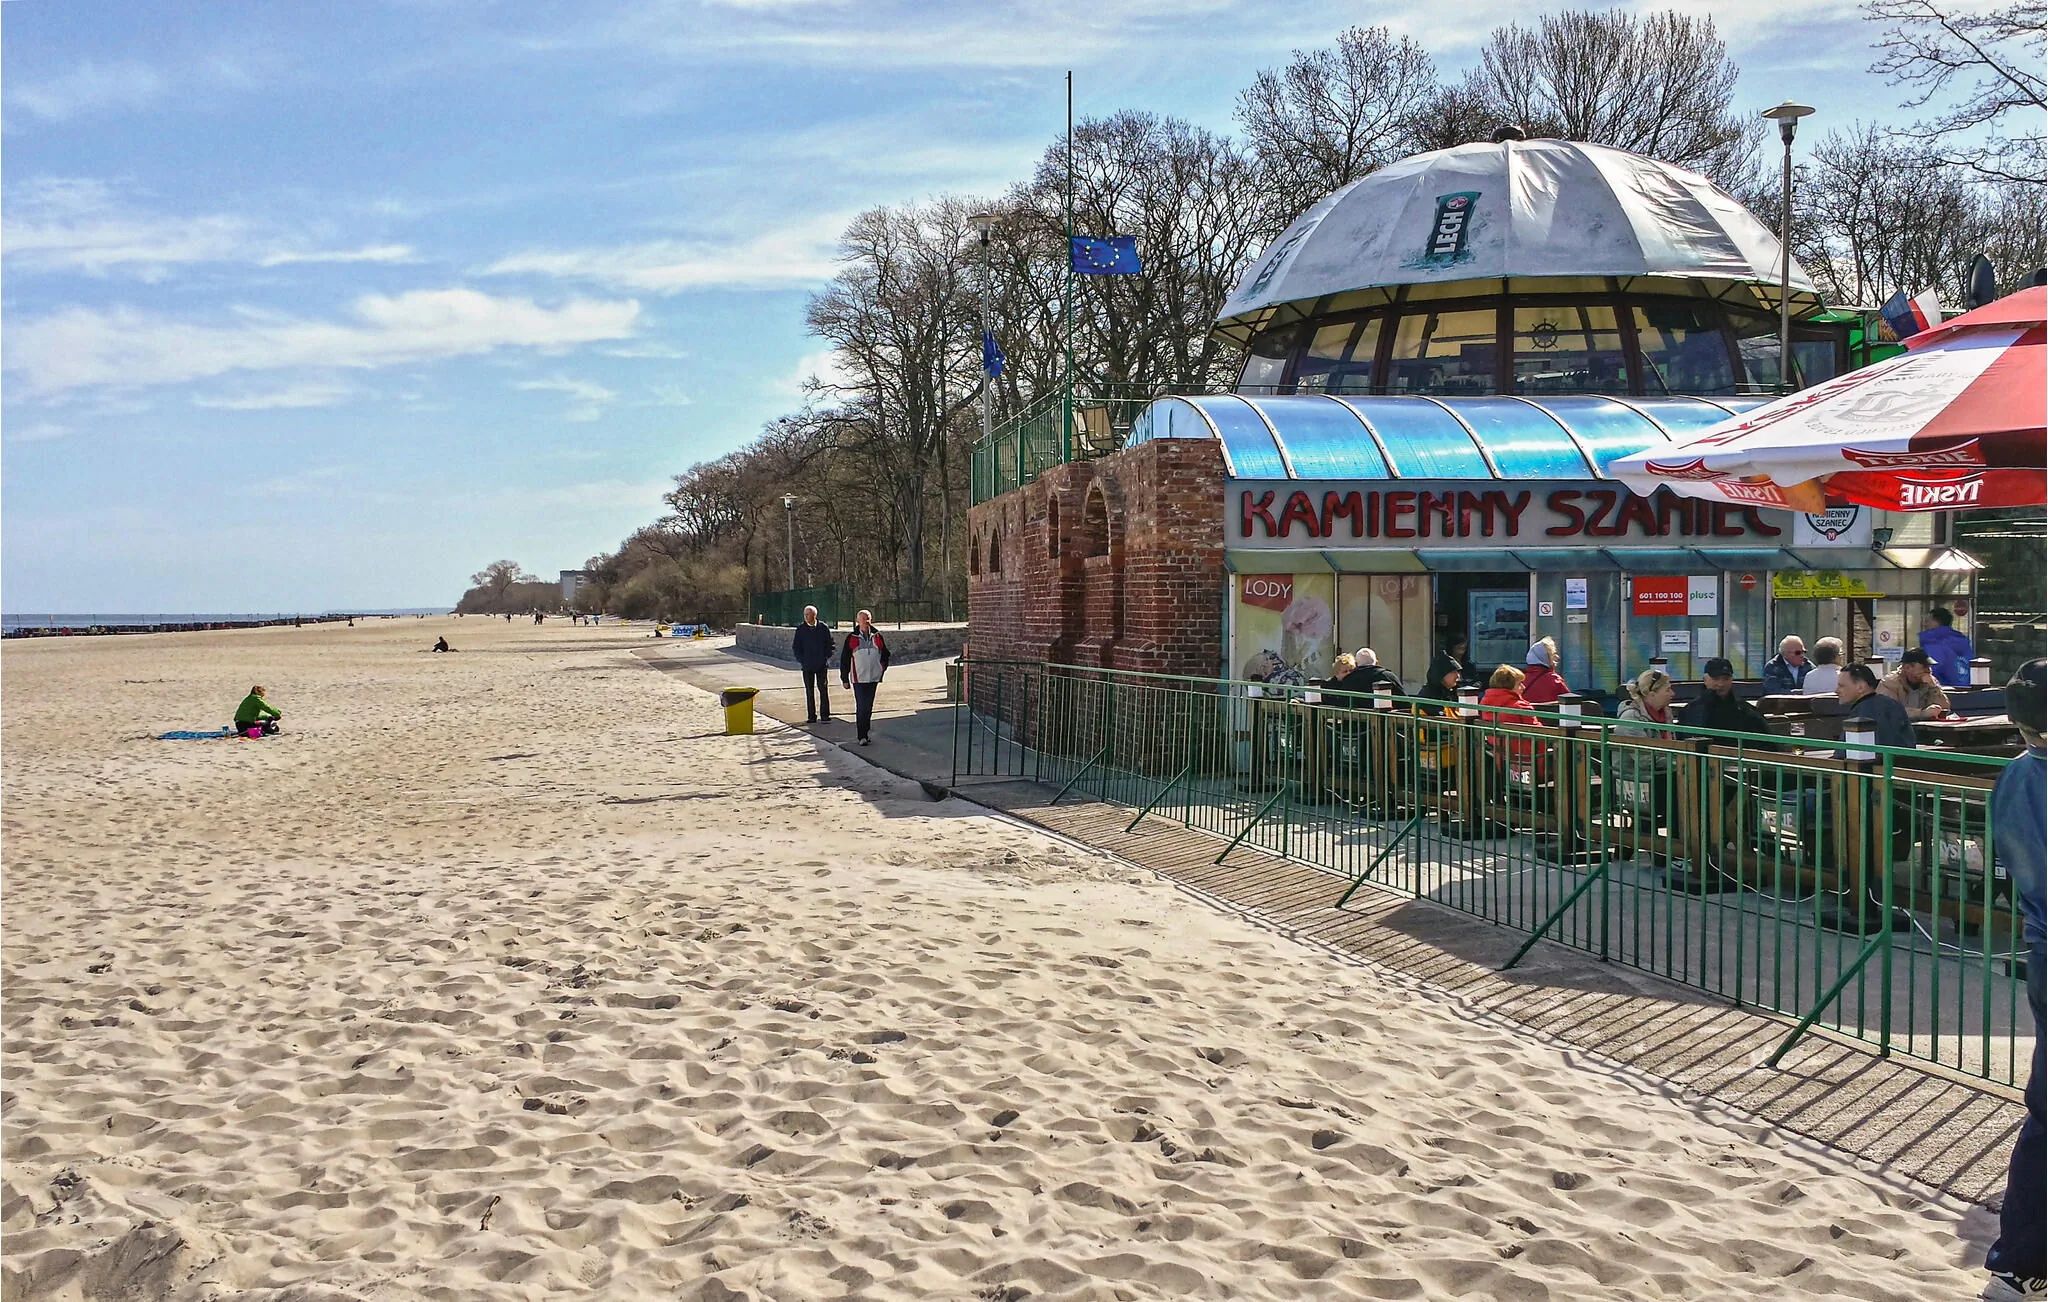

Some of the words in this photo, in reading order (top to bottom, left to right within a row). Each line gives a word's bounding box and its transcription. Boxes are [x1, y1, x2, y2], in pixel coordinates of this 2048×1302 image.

[1433, 211, 1465, 254] LECH
[1855, 450, 1977, 465] TYSKIE
[1240, 490, 1532, 538] KAMIENNY
[1545, 490, 1782, 537] SZANIEC
[1816, 519, 1848, 527] SZANIEC
[1245, 579, 1292, 599] LODY
[1639, 592, 1652, 600] 601
[1655, 592, 1668, 600] 100
[1670, 592, 1684, 600] 100
[1690, 591, 1708, 601] plus
